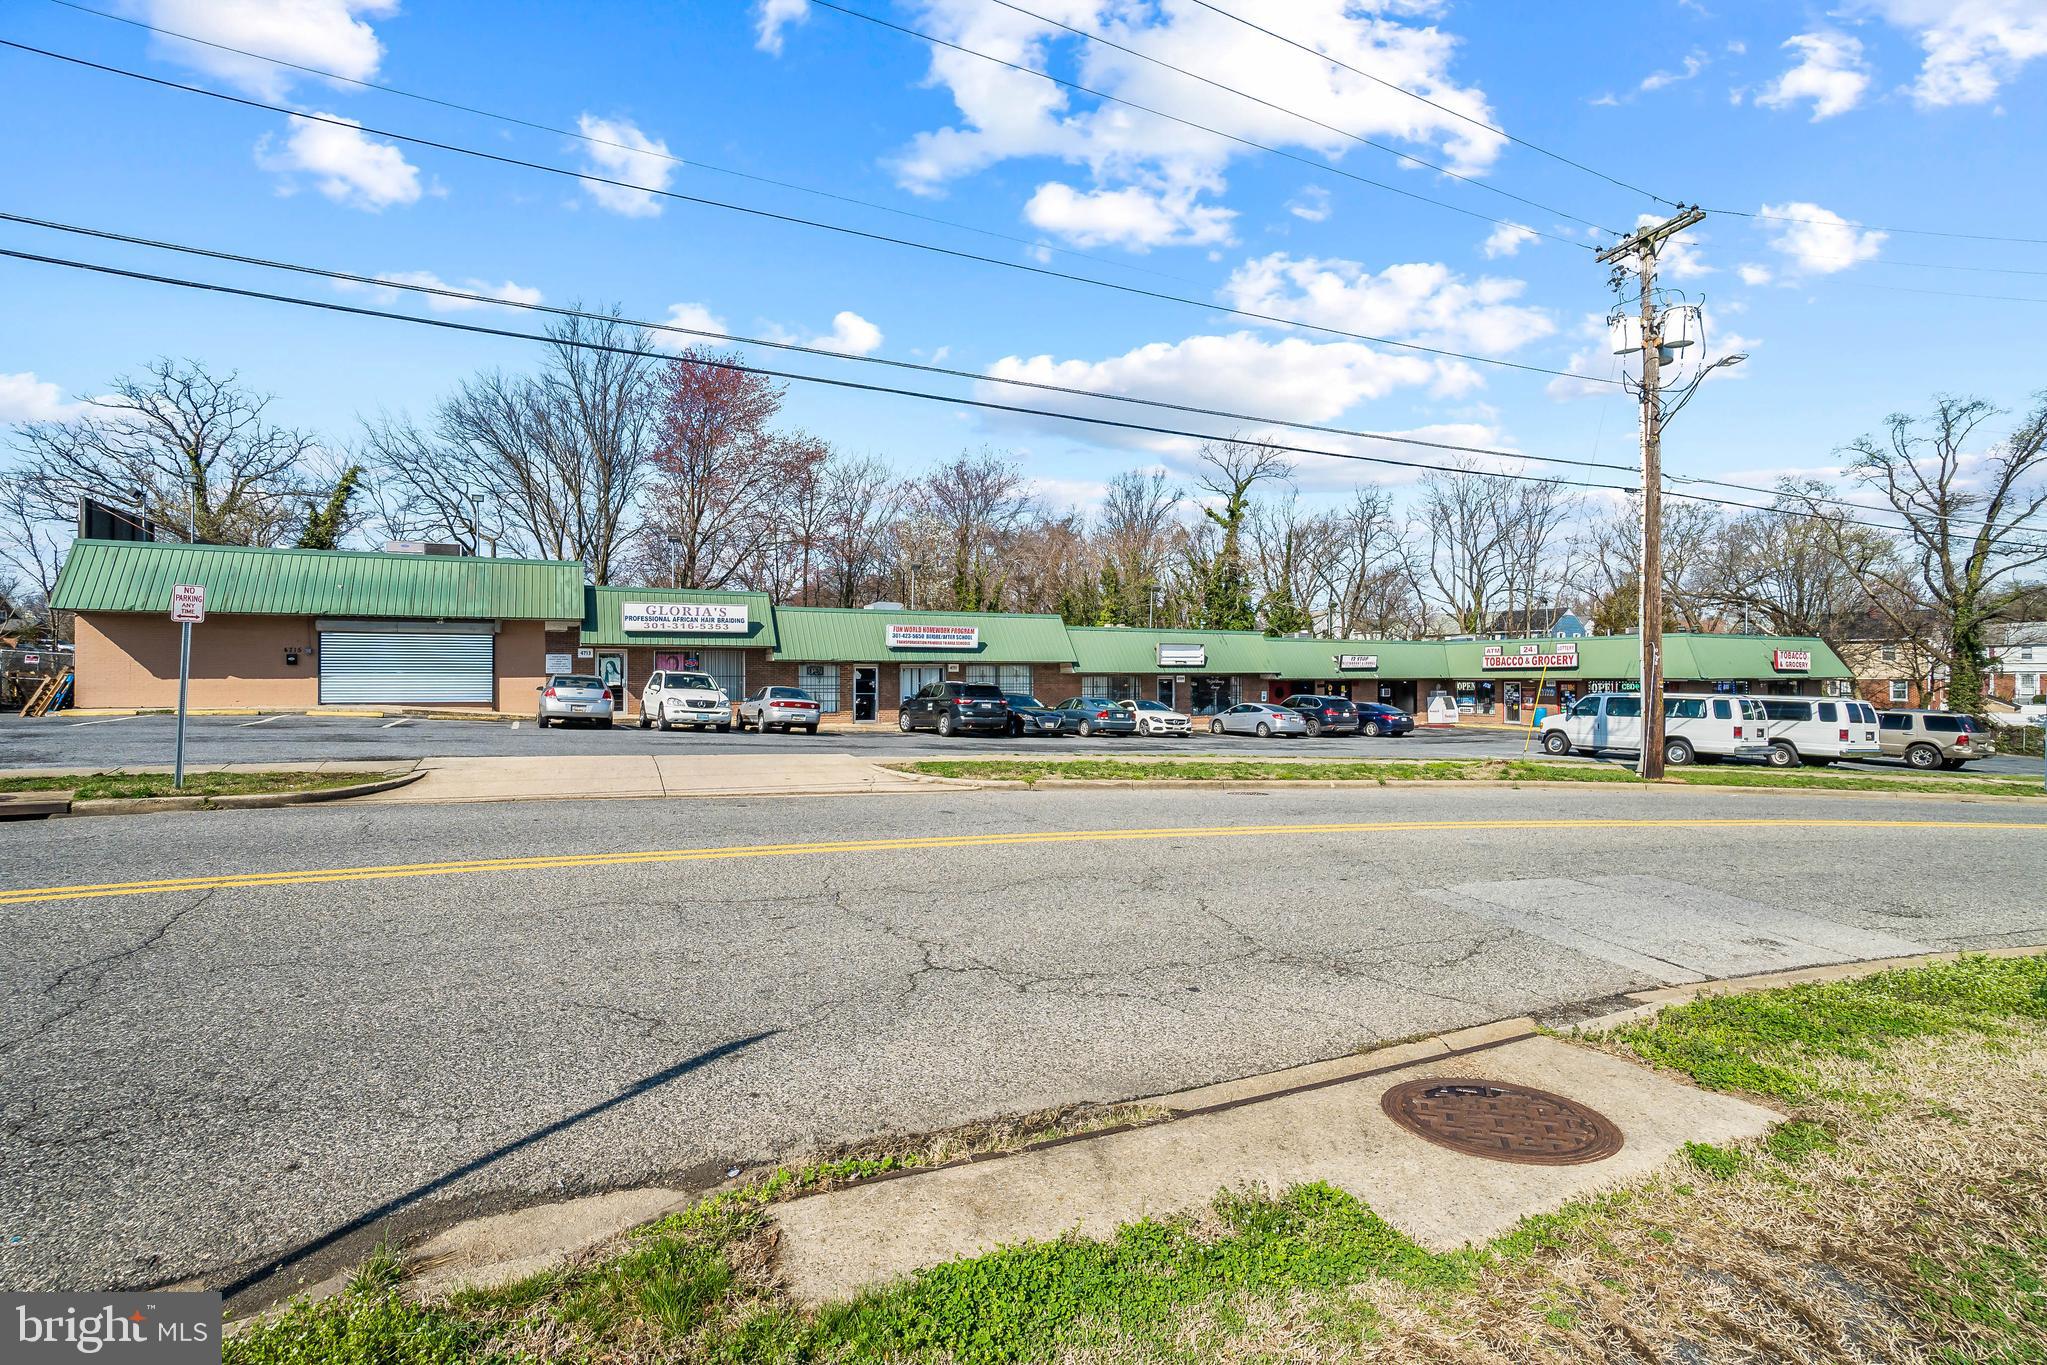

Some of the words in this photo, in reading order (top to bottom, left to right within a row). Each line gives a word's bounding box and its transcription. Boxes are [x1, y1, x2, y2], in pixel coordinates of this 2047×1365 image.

[176, 594, 203, 602] PARKING
[645, 605, 727, 617] GLORIA'S
[643, 622, 729, 630] 301-316-5353
[1780, 651, 1808, 659] TOBACCO
[1485, 656, 1524, 666] TOBACCO
[1531, 655, 1574, 666] GROCERY
[1457, 681, 1476, 690] OPEN
